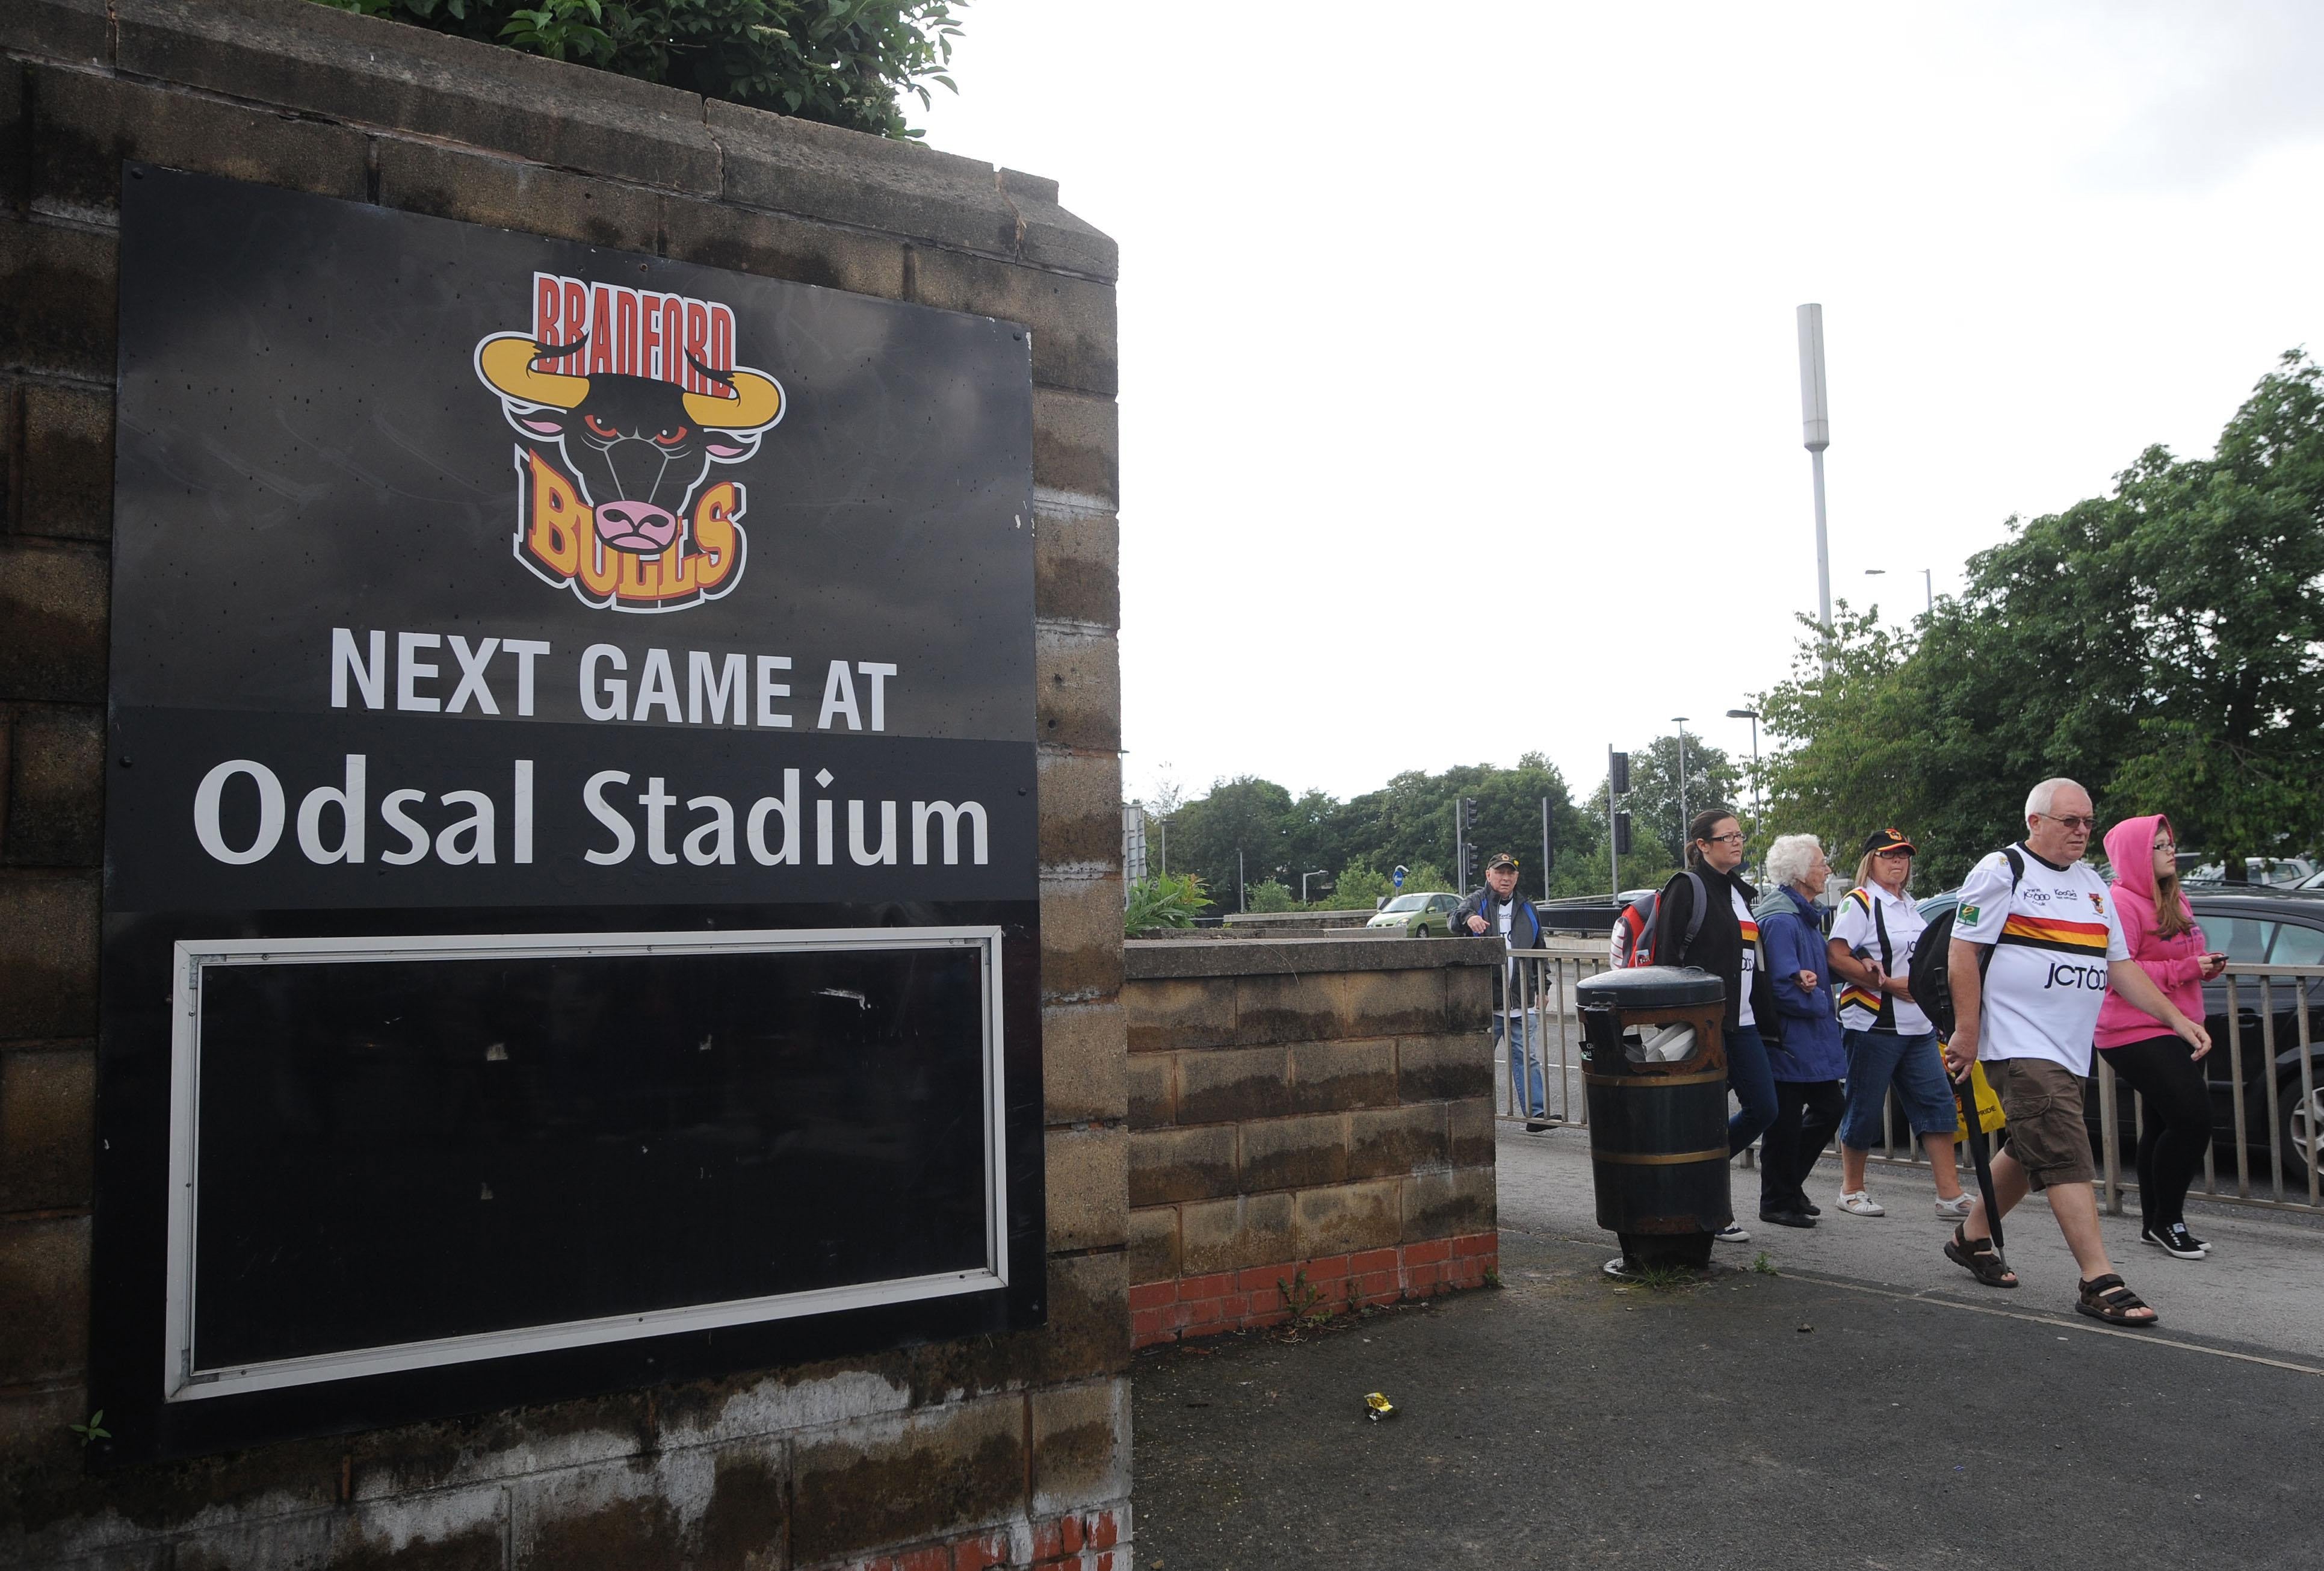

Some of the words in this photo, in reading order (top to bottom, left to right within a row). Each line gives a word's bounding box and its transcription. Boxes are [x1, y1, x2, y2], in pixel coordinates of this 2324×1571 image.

[534, 271, 736, 400] BRADFORD
[526, 447, 738, 601] BULLS
[331, 627, 551, 716] NEXT
[579, 643, 793, 728] GAME
[817, 660, 897, 731] AT
[194, 754, 533, 866] Odsal
[583, 767, 988, 866] Stadium
[2044, 963, 2106, 991] JCT60
